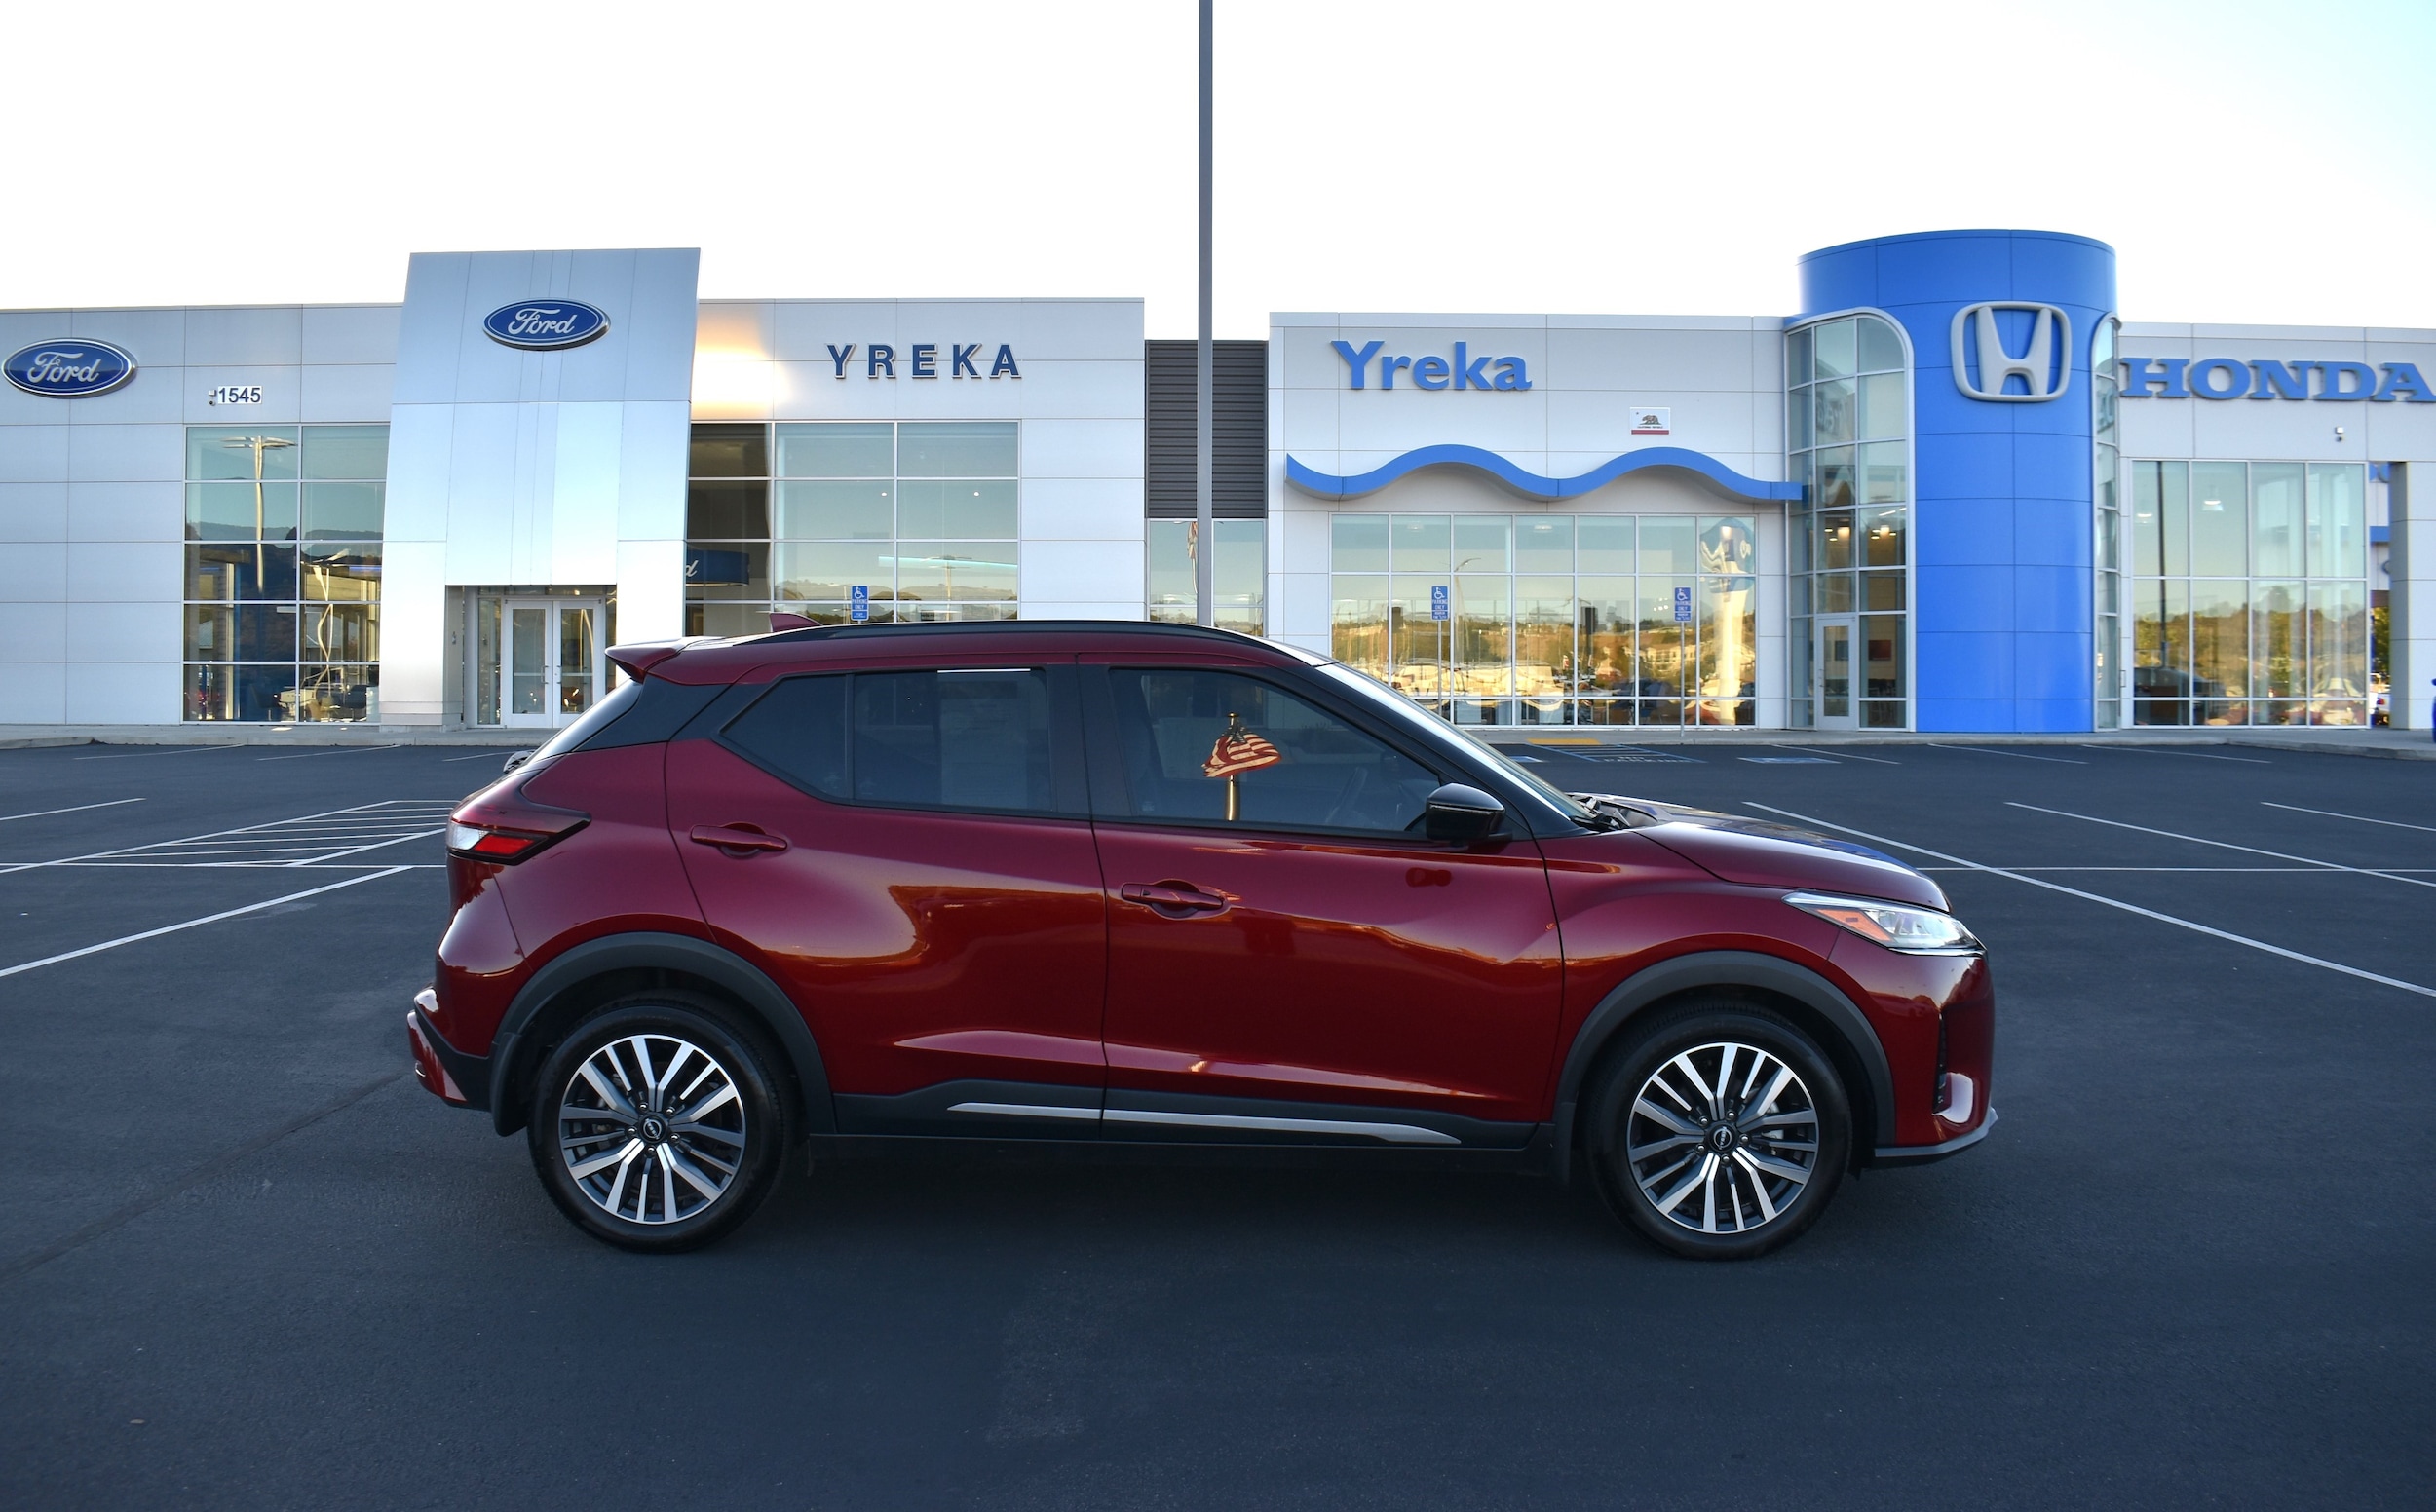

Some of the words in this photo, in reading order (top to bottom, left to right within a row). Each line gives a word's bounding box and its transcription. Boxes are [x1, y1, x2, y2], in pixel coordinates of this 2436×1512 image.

[508, 308, 578, 335] Ford
[26, 351, 102, 383] Ford
[826, 343, 1023, 379] YREKA
[1330, 340, 1533, 391] Yreka
[218, 387, 261, 403] 1545
[2119, 357, 2436, 402] HONDA
